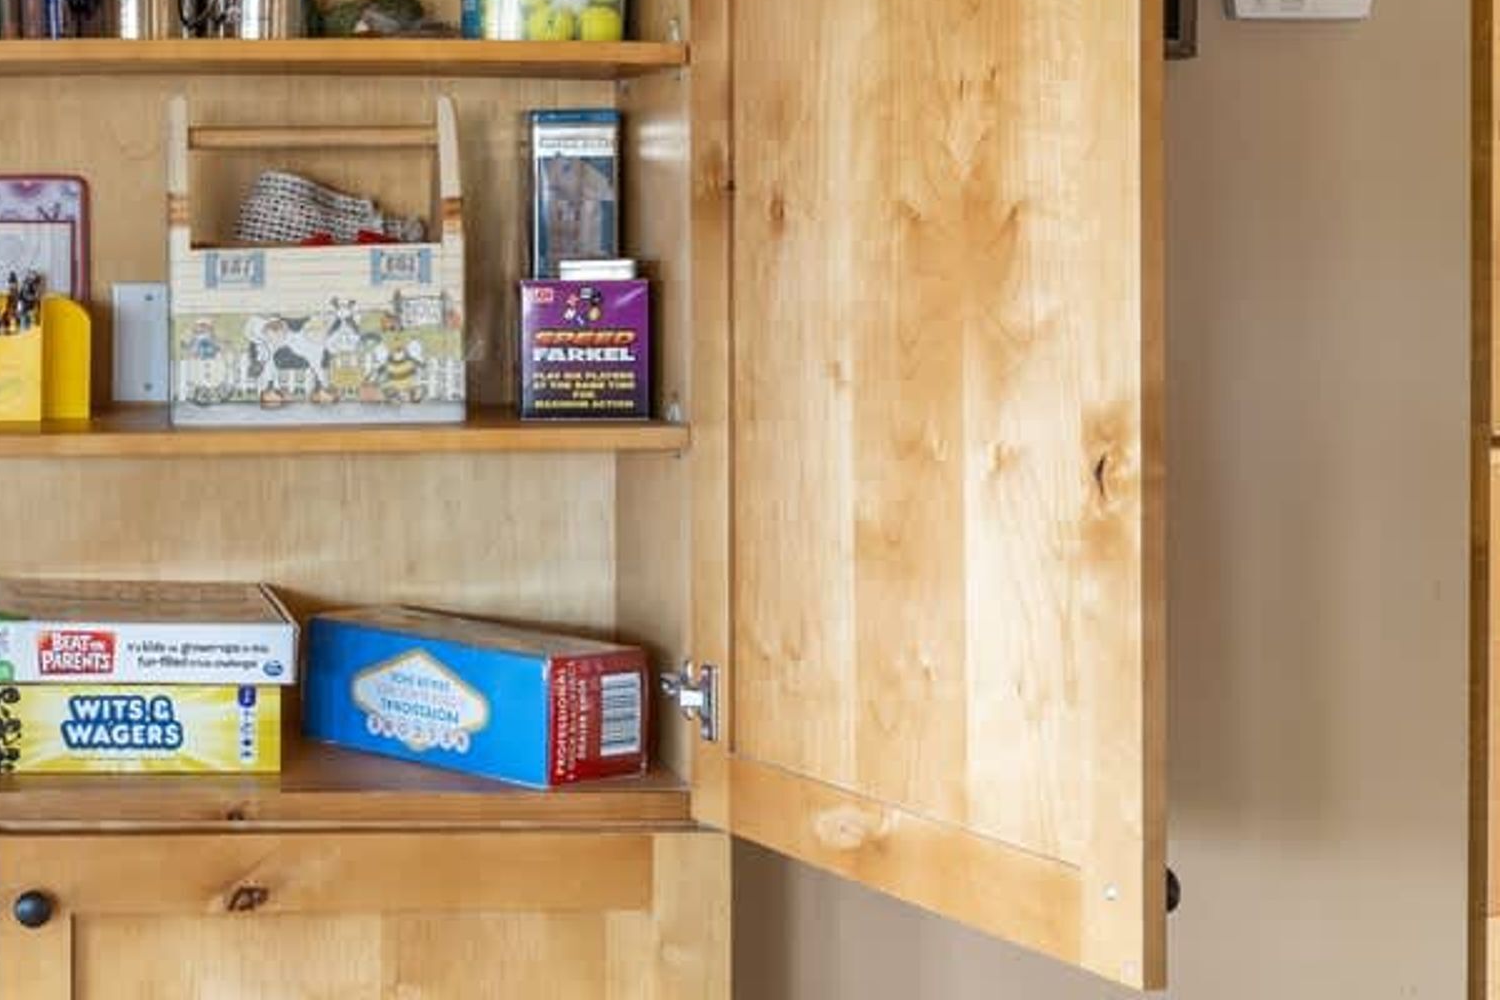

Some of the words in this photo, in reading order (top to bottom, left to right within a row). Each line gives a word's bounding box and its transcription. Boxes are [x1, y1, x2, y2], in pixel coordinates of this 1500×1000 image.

[534, 330, 636, 346] SPEED
[533, 347, 636, 361] FARKEL
[585, 371, 635, 380] PLAYERS
[550, 381, 571, 390] THE
[575, 381, 605, 390] SAME
[572, 391, 595, 399] FOR
[593, 400, 634, 409] ACTION
[52, 632, 88, 651] BEAT
[41, 650, 110, 672] PARENTS
[72, 698, 141, 720] WITS
[150, 698, 171, 720] &
[555, 668, 567, 776] PROFESSIONAL
[64, 724, 182, 746] WAGERS
